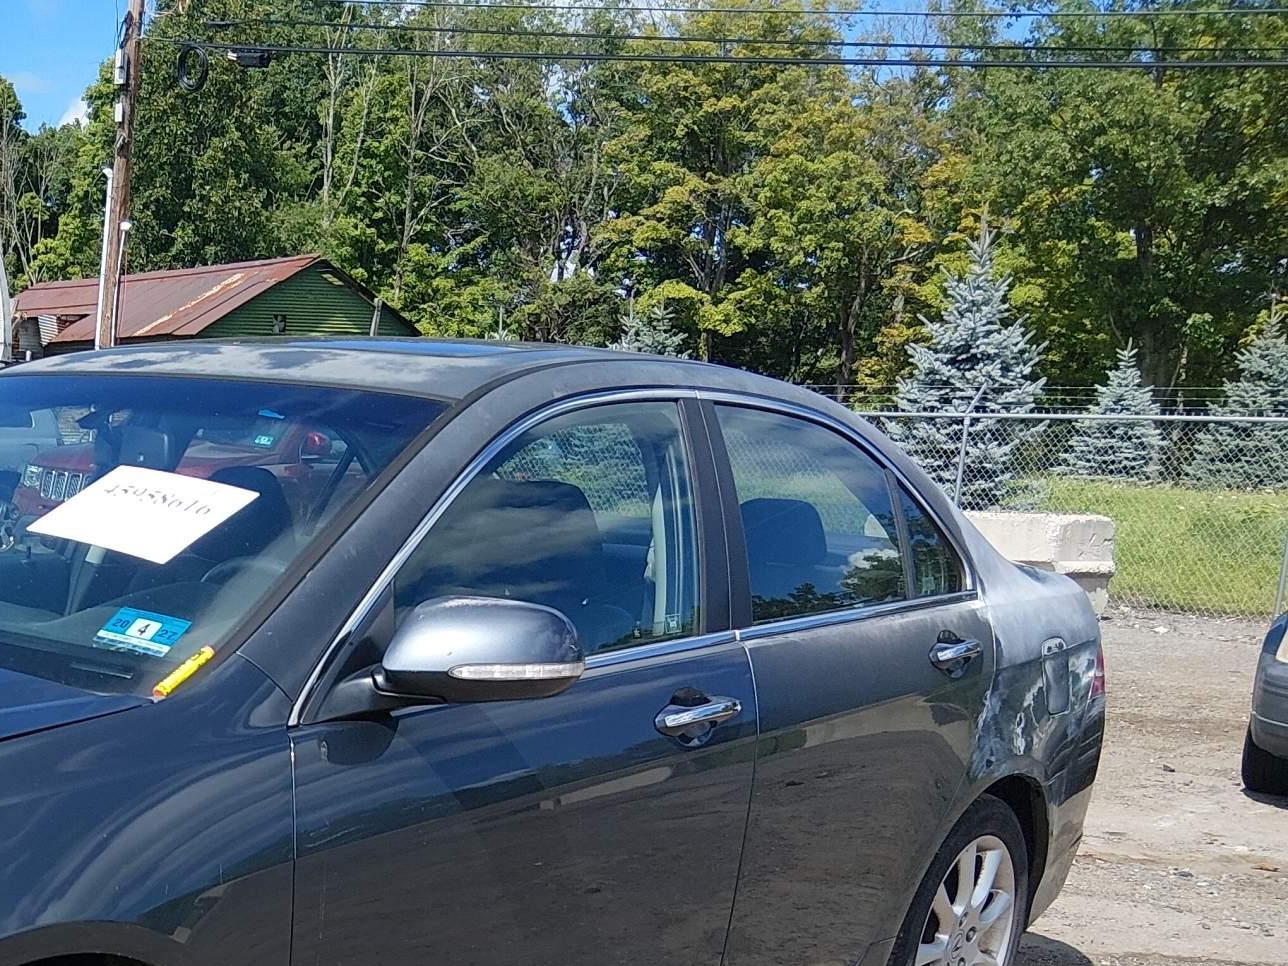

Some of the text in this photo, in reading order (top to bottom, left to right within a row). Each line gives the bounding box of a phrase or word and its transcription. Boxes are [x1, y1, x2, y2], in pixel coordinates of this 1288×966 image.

[112, 618, 179, 640] 20 4 27
